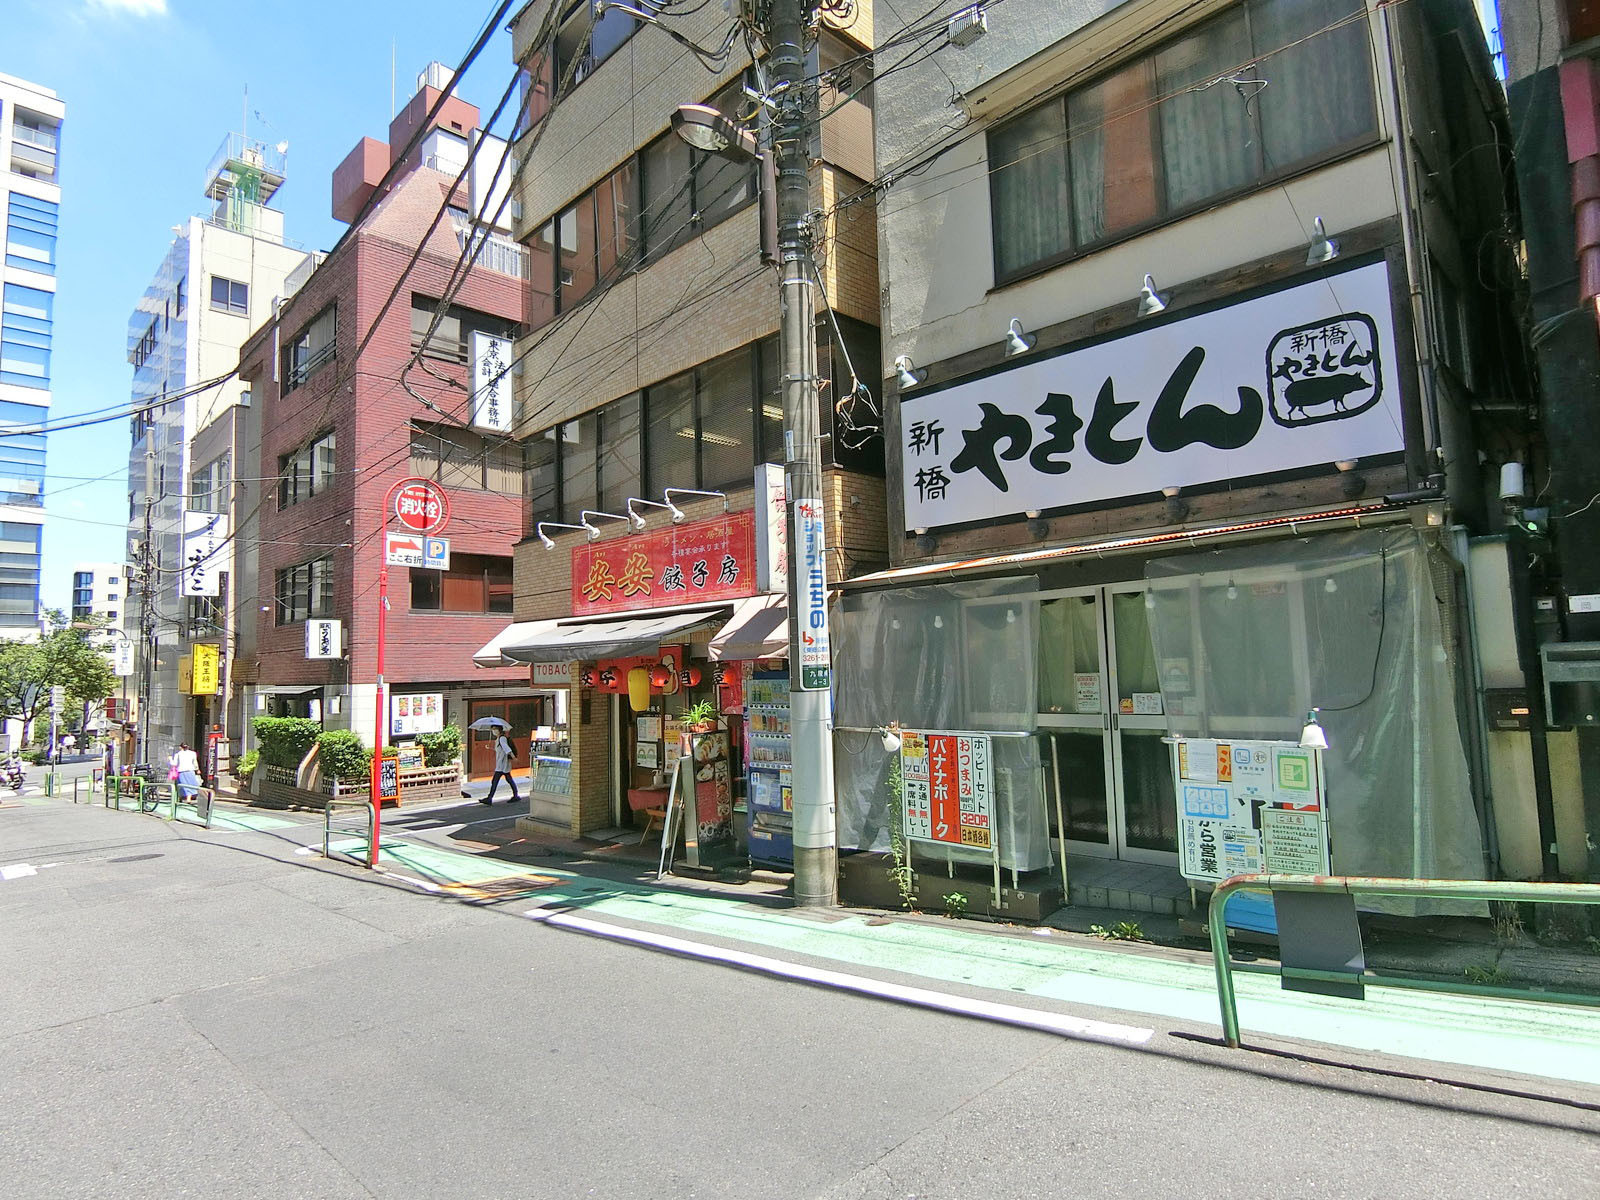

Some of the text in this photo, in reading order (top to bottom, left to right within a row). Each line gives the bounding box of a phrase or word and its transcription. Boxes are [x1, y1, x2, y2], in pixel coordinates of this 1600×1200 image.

[489, 339, 499, 359] 東京
[1290, 324, 1348, 354] 新橋
[1272, 340, 1373, 383] やきとん
[950, 346, 1264, 492] やきとん
[908, 419, 950, 503] 新橋
[401, 497, 438, 518] 消火栓
[389, 554, 423, 564] ここ右折
[658, 554, 740, 592] 餃子房
[960, 739, 972, 796] おつまみ
[974, 740, 985, 813] ホッピーセット
[932, 739, 949, 838] バナナポーク
[961, 812, 989, 827] 320円
[962, 829, 989, 845] 日本酒各種
